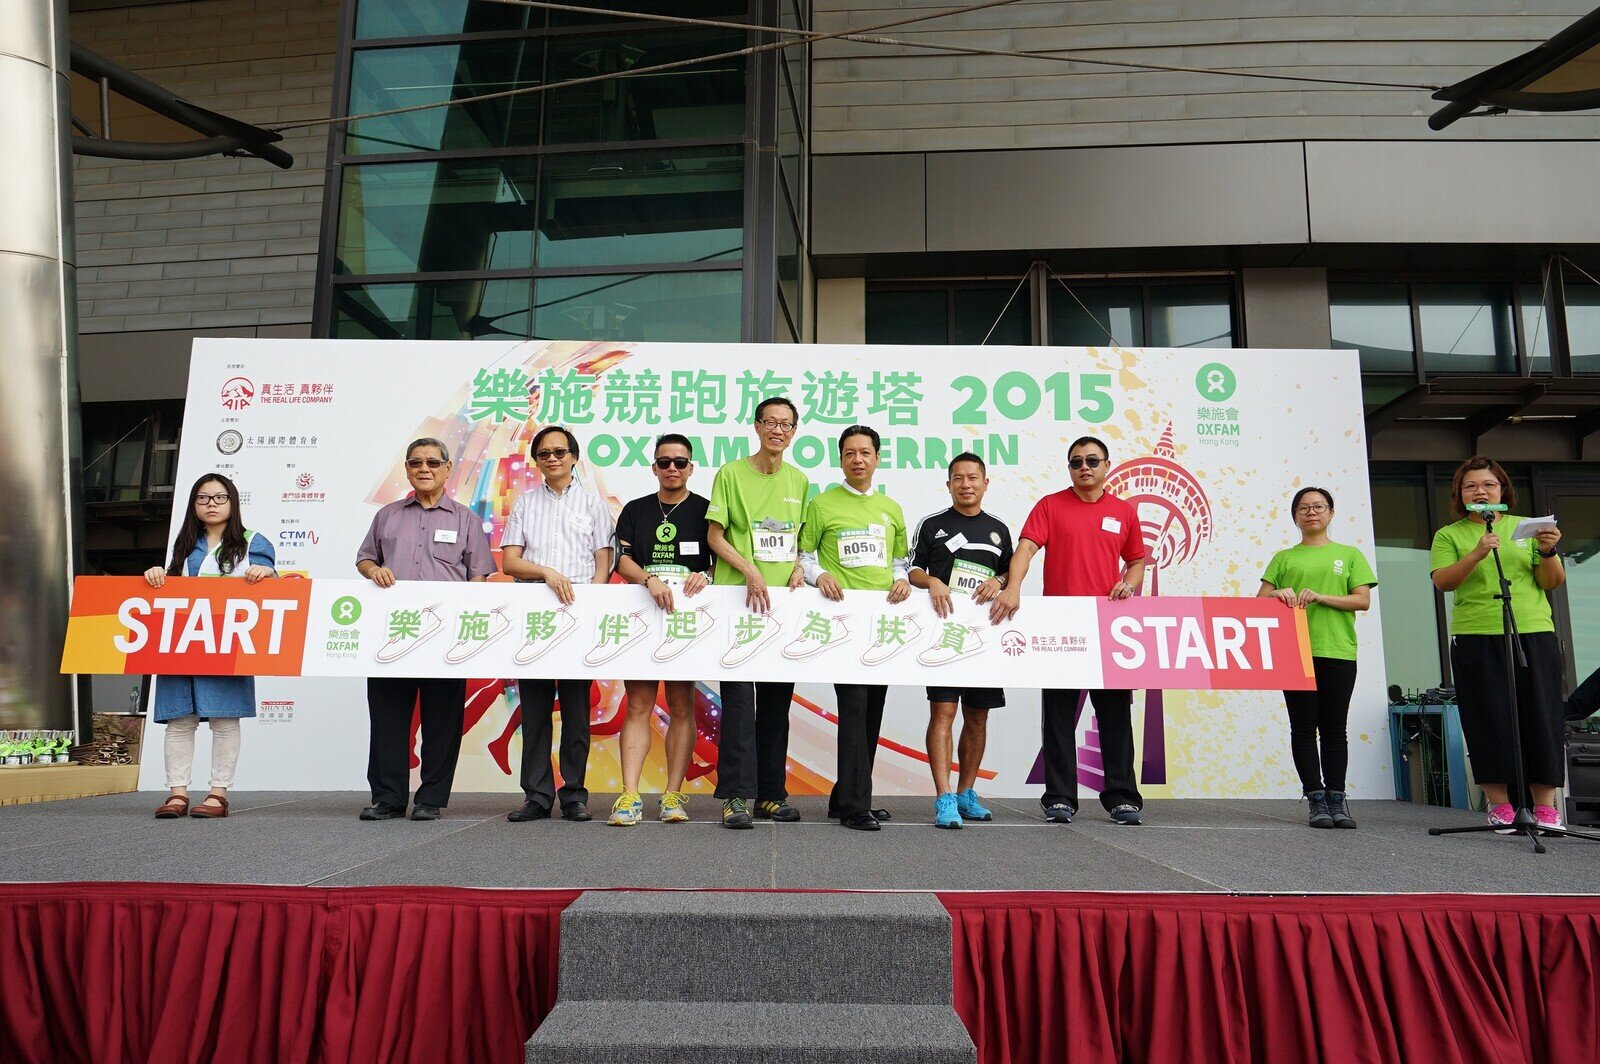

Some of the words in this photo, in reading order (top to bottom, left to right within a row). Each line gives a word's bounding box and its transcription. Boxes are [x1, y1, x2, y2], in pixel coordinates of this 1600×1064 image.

[260, 383, 294, 396] 真生活
[299, 383, 334, 396] 真夥伴
[222, 398, 251, 411] AIA
[260, 396, 272, 404] THE
[272, 396, 288, 404] REAL
[288, 396, 301, 404] LIFE
[301, 396, 334, 404] COMPANY
[949, 371, 1115, 425] 2015
[1196, 406, 1240, 421] 樂施會
[1196, 423, 1240, 436] OXFAM
[1199, 437, 1219, 447] Hong
[1219, 437, 1239, 447] Kong
[587, 433, 751, 468] OXAM
[279, 531, 306, 539] CTM
[760, 535, 784, 548] M01
[844, 541, 876, 555] R05D
[652, 551, 675, 560] OXFAM
[113, 597, 299, 655] START
[328, 628, 361, 640] 樂施會
[1031, 635, 1057, 646] 真生活
[1061, 635, 1087, 646] 真夥伴
[326, 641, 359, 651] OXFAM
[1109, 615, 1280, 671] START
[326, 652, 342, 660] Hong
[342, 652, 357, 660] Kong
[1003, 647, 1025, 657] AIA
